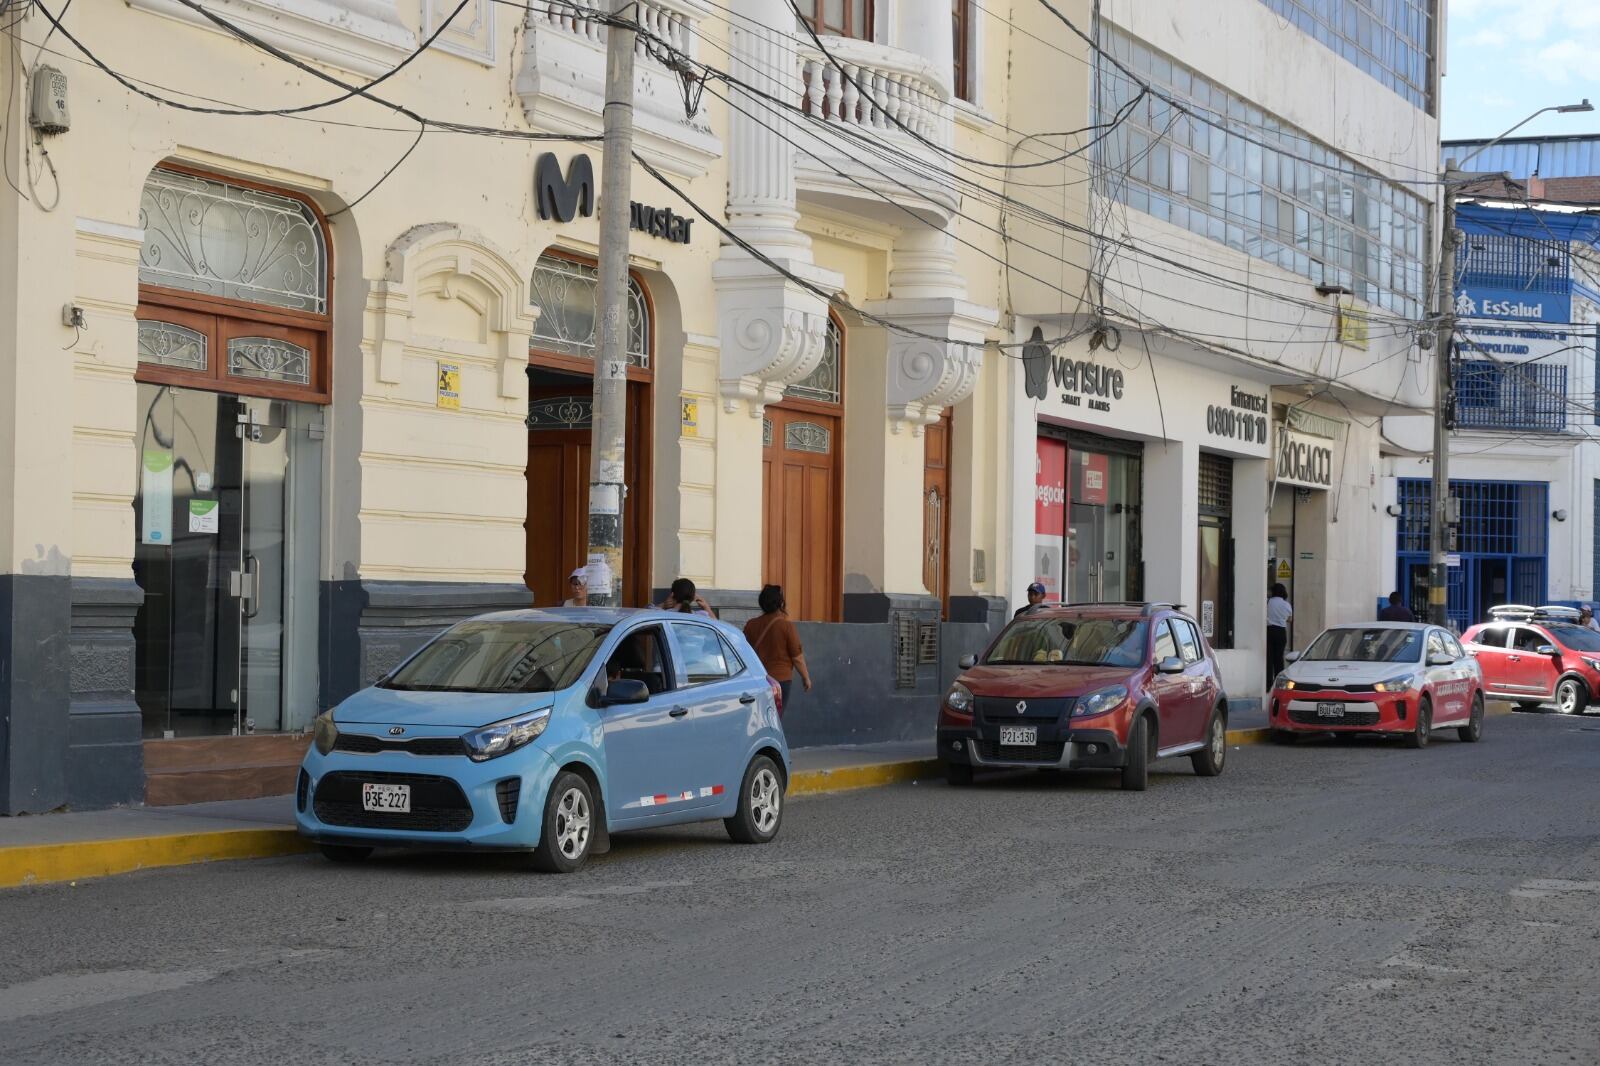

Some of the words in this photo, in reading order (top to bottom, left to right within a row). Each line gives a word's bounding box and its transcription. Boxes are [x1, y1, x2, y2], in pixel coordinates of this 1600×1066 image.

[1483, 300, 1542, 318] EsSalud
[1052, 355, 1123, 400] verisure
[390, 727, 404, 735] KIA
[364, 791, 407, 809] P3E-227
